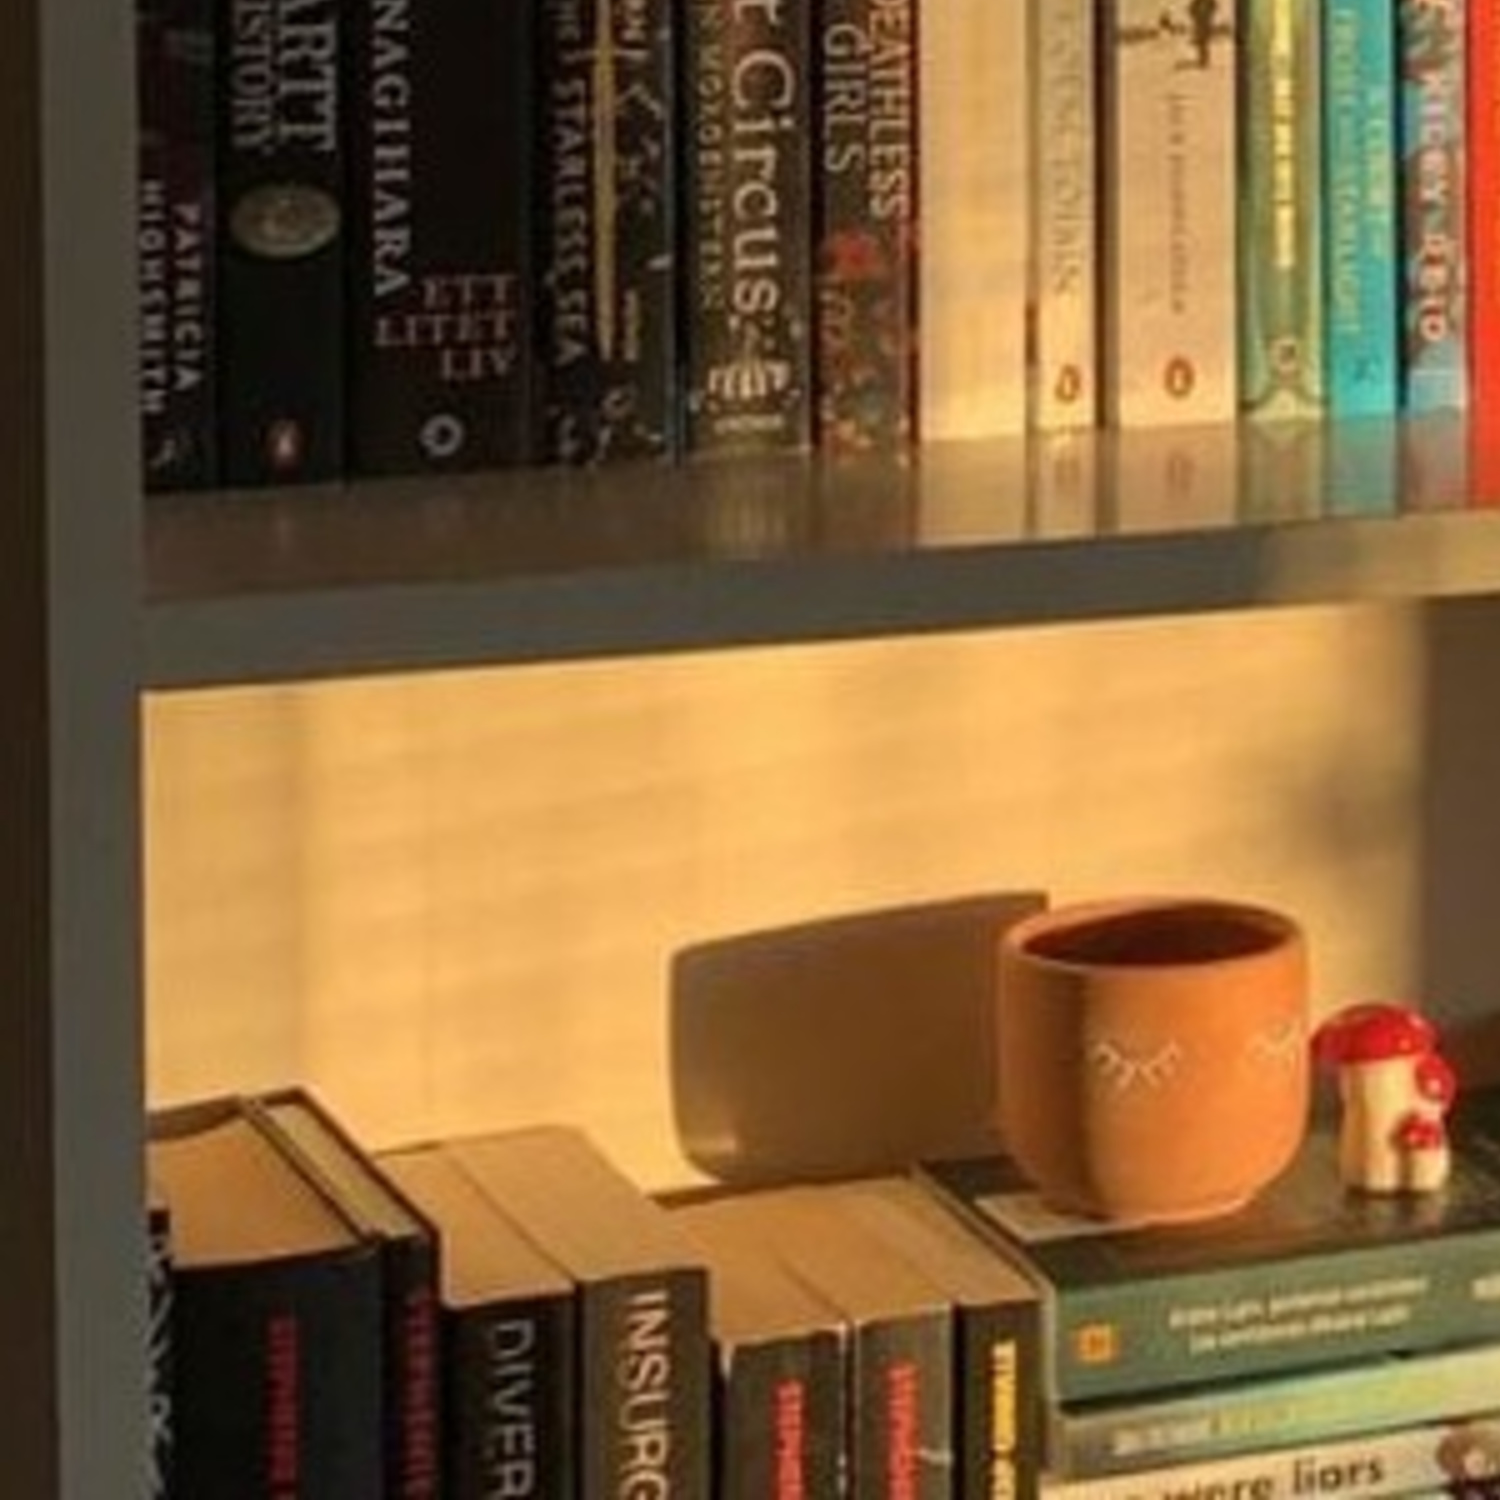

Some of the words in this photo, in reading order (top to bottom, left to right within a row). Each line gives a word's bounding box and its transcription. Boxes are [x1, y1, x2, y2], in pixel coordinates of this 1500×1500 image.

[551, 77, 590, 271] STARLESS
[730, 49, 797, 315] Circus
[821, 21, 866, 175] GIRLS
[170, 202, 203, 391] PATRICIA
[552, 290, 590, 367] SEA
[1292, 1454, 1388, 1497] liars
